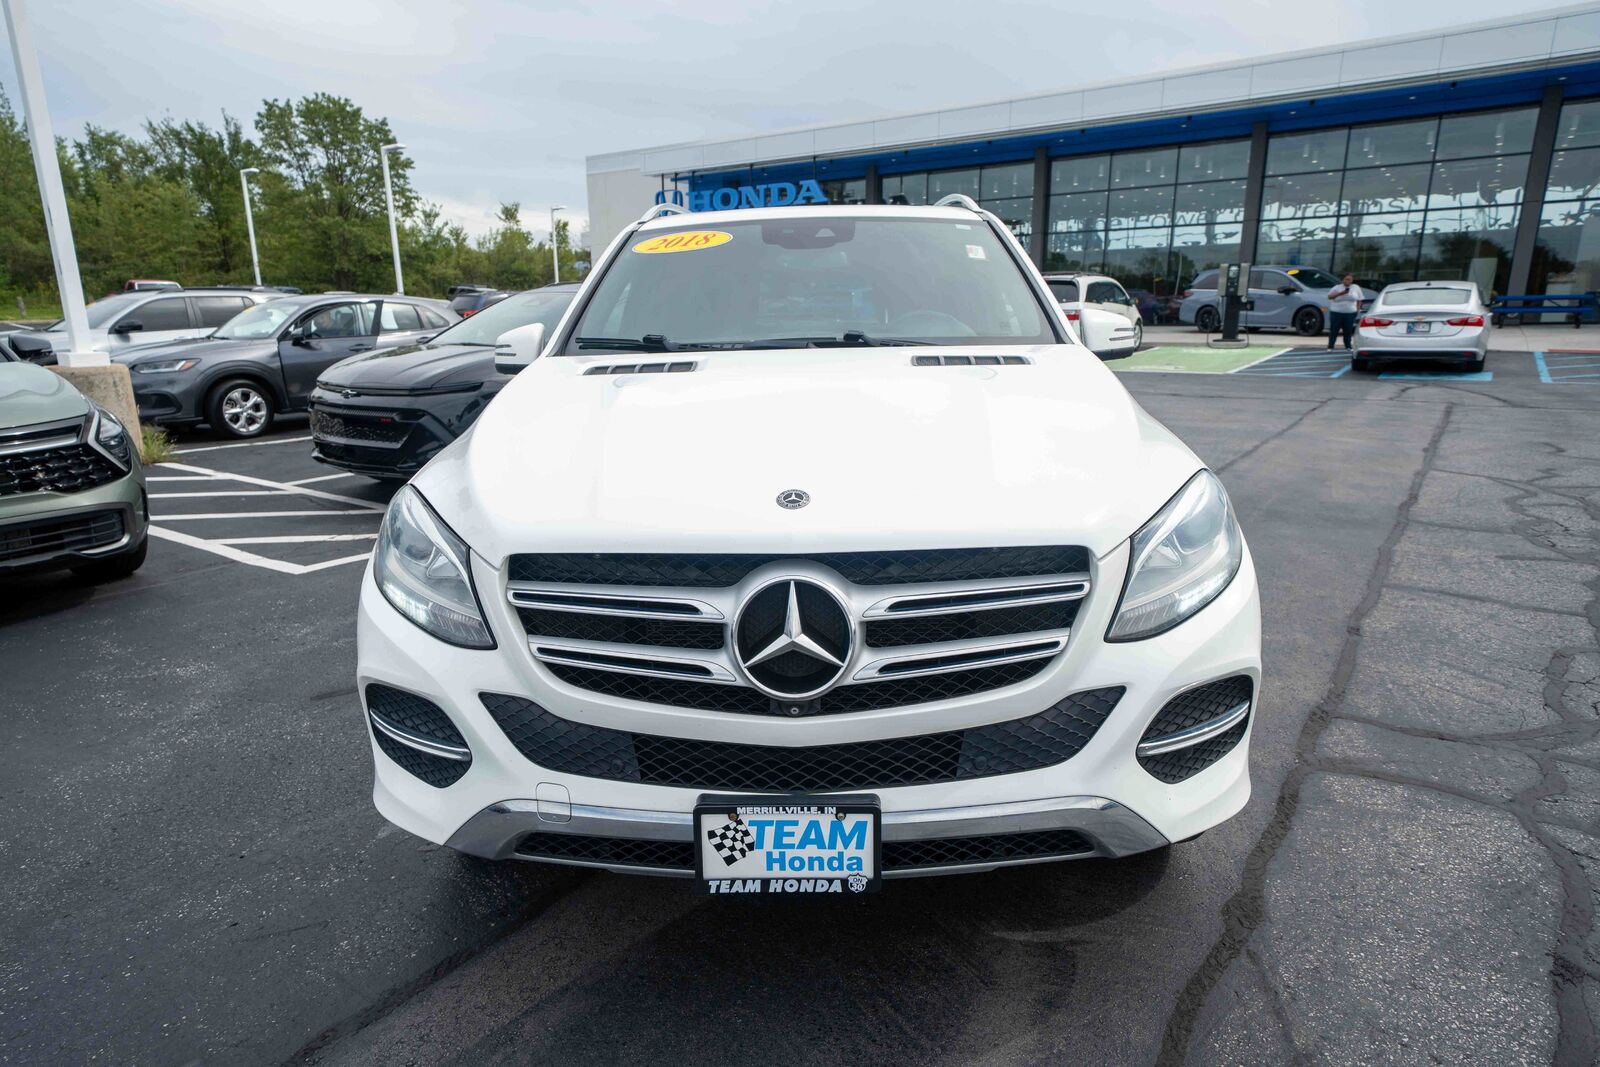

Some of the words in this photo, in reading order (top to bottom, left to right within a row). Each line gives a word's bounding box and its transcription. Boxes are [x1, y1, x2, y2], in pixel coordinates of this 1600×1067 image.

[686, 179, 828, 213] HONDA
[648, 232, 717, 251] 2018
[736, 806, 821, 815] MERRILLVILLE,
[824, 806, 837, 815] IN
[747, 819, 868, 850] TEAM
[766, 851, 863, 872] Honda
[708, 879, 761, 894] TEAM
[768, 879, 843, 893] HONDA
